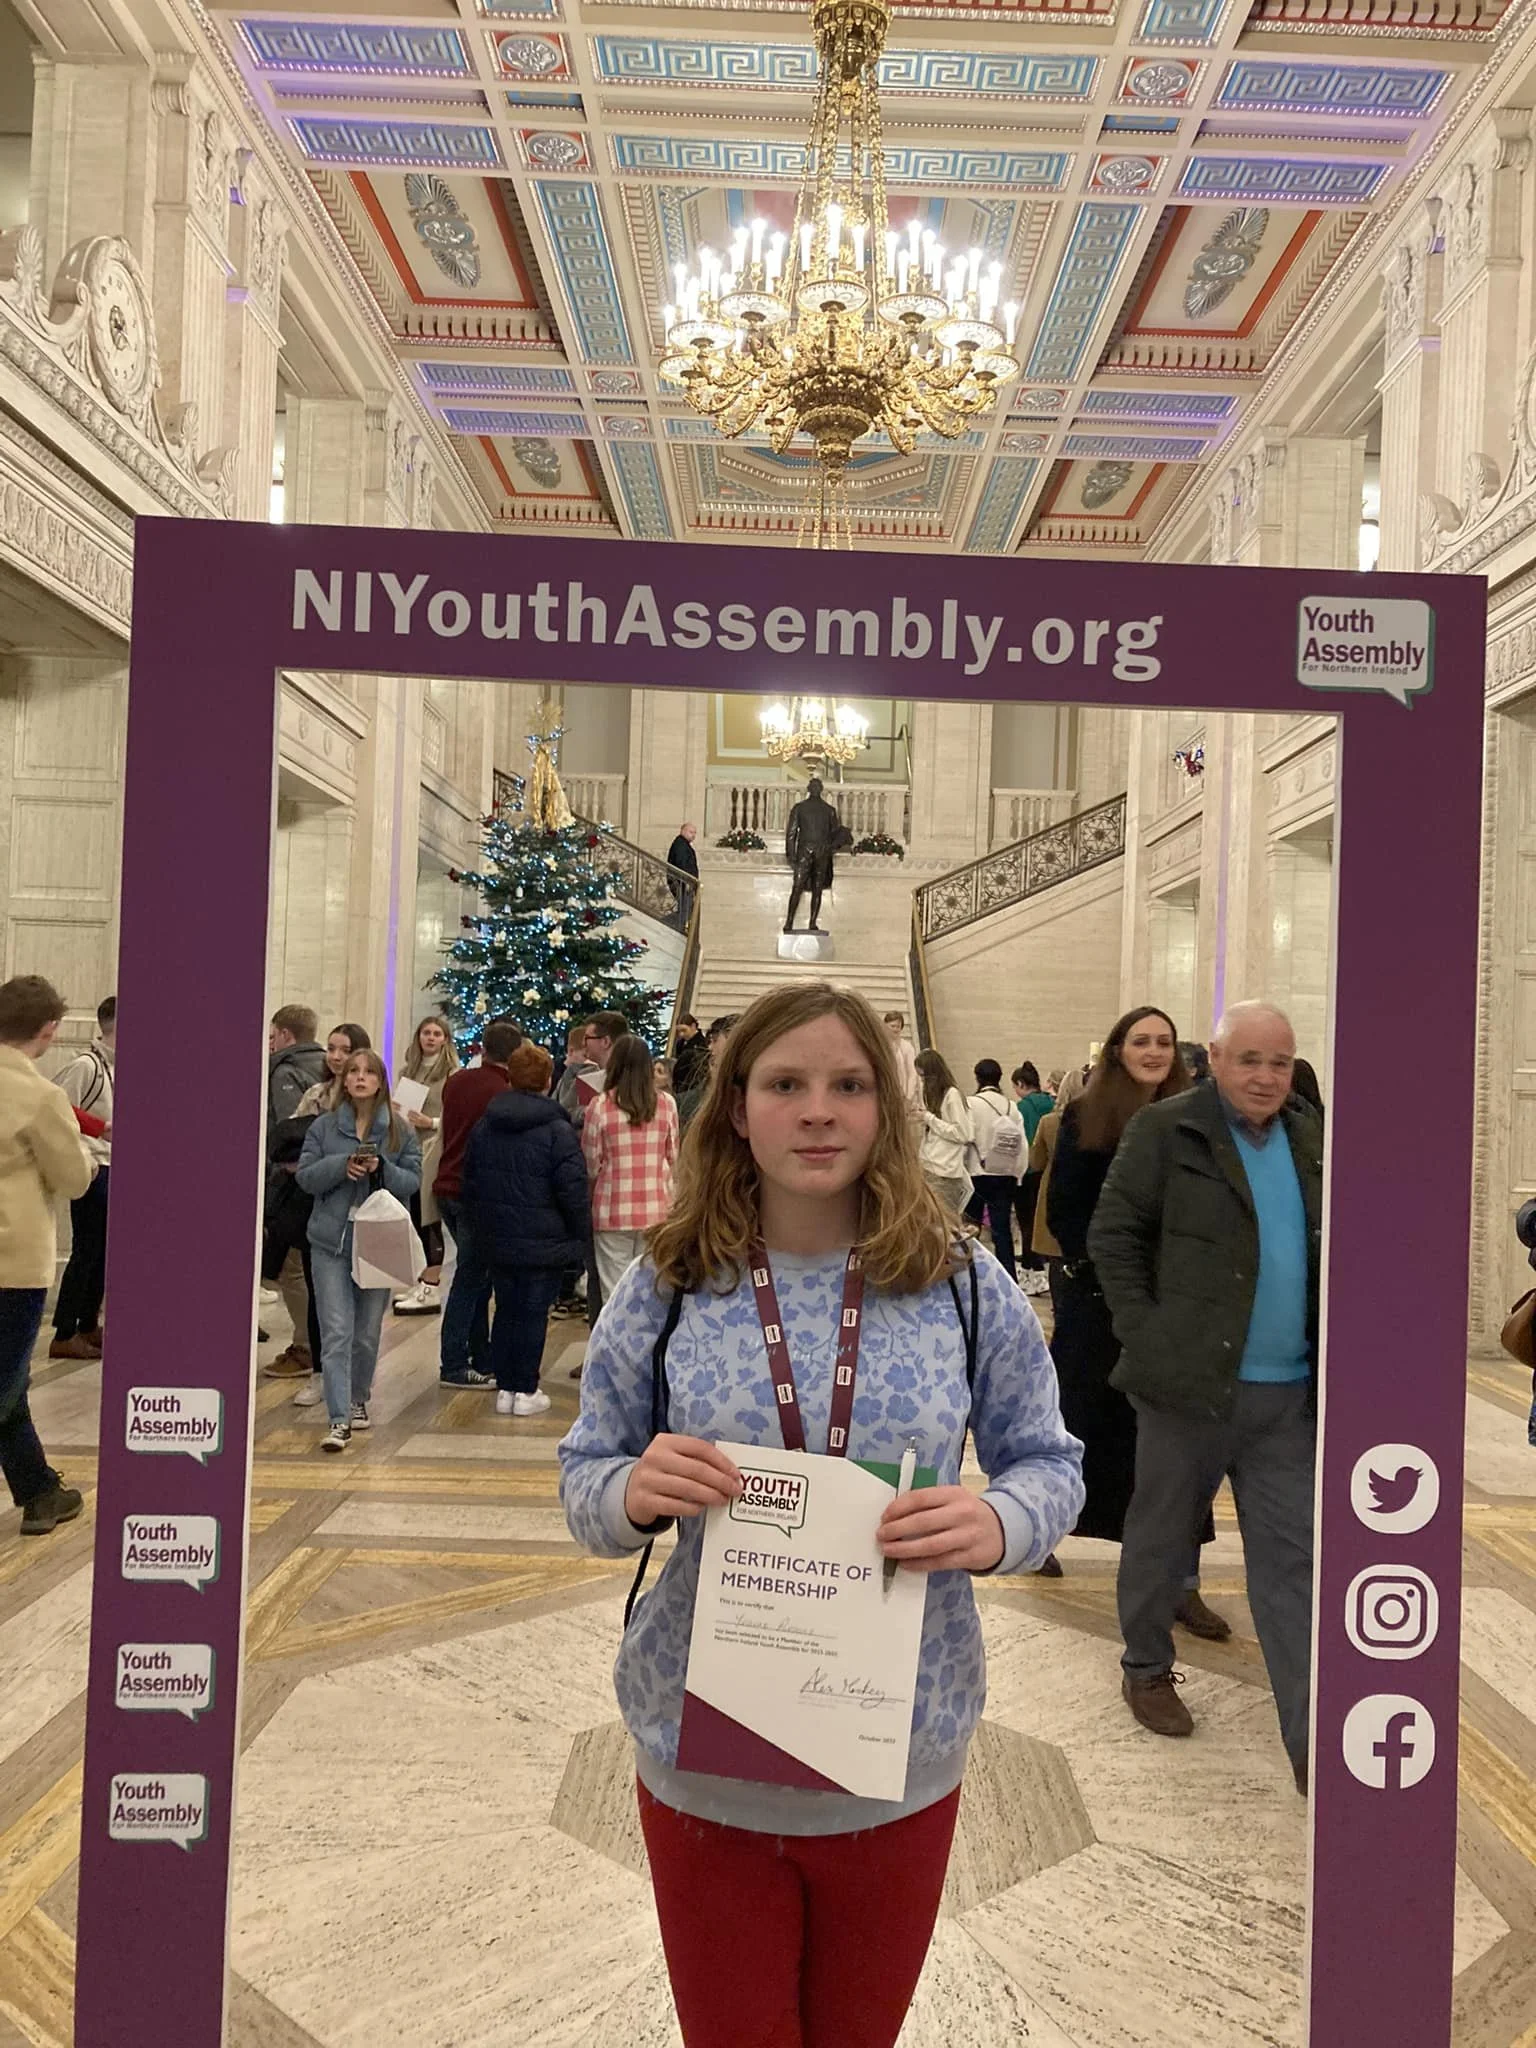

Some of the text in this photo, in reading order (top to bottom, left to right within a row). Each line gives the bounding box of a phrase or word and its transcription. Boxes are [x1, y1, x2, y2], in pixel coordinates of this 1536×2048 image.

[292, 569, 1163, 682] NIYouthAssembly.org
[1304, 607, 1374, 633] Youth
[1302, 637, 1425, 671] Assembly
[1302, 663, 1408, 675] For Northern Ireland
[131, 1394, 181, 1413] Youth
[129, 1416, 217, 1439] Assembly
[740, 1473, 801, 1498] YOUTH
[738, 1493, 799, 1512] ASSEMBLY
[127, 1522, 177, 1540] Youth
[126, 1544, 214, 1567] Assembly
[724, 1548, 872, 1581] CERTIFICATE OF
[721, 1571, 838, 1600] MEMBERSHIP
[121, 1651, 171, 1669] Youth
[120, 1673, 208, 1695] Assembly
[115, 1781, 166, 1799] Youth
[113, 1803, 202, 1826] Assembly
